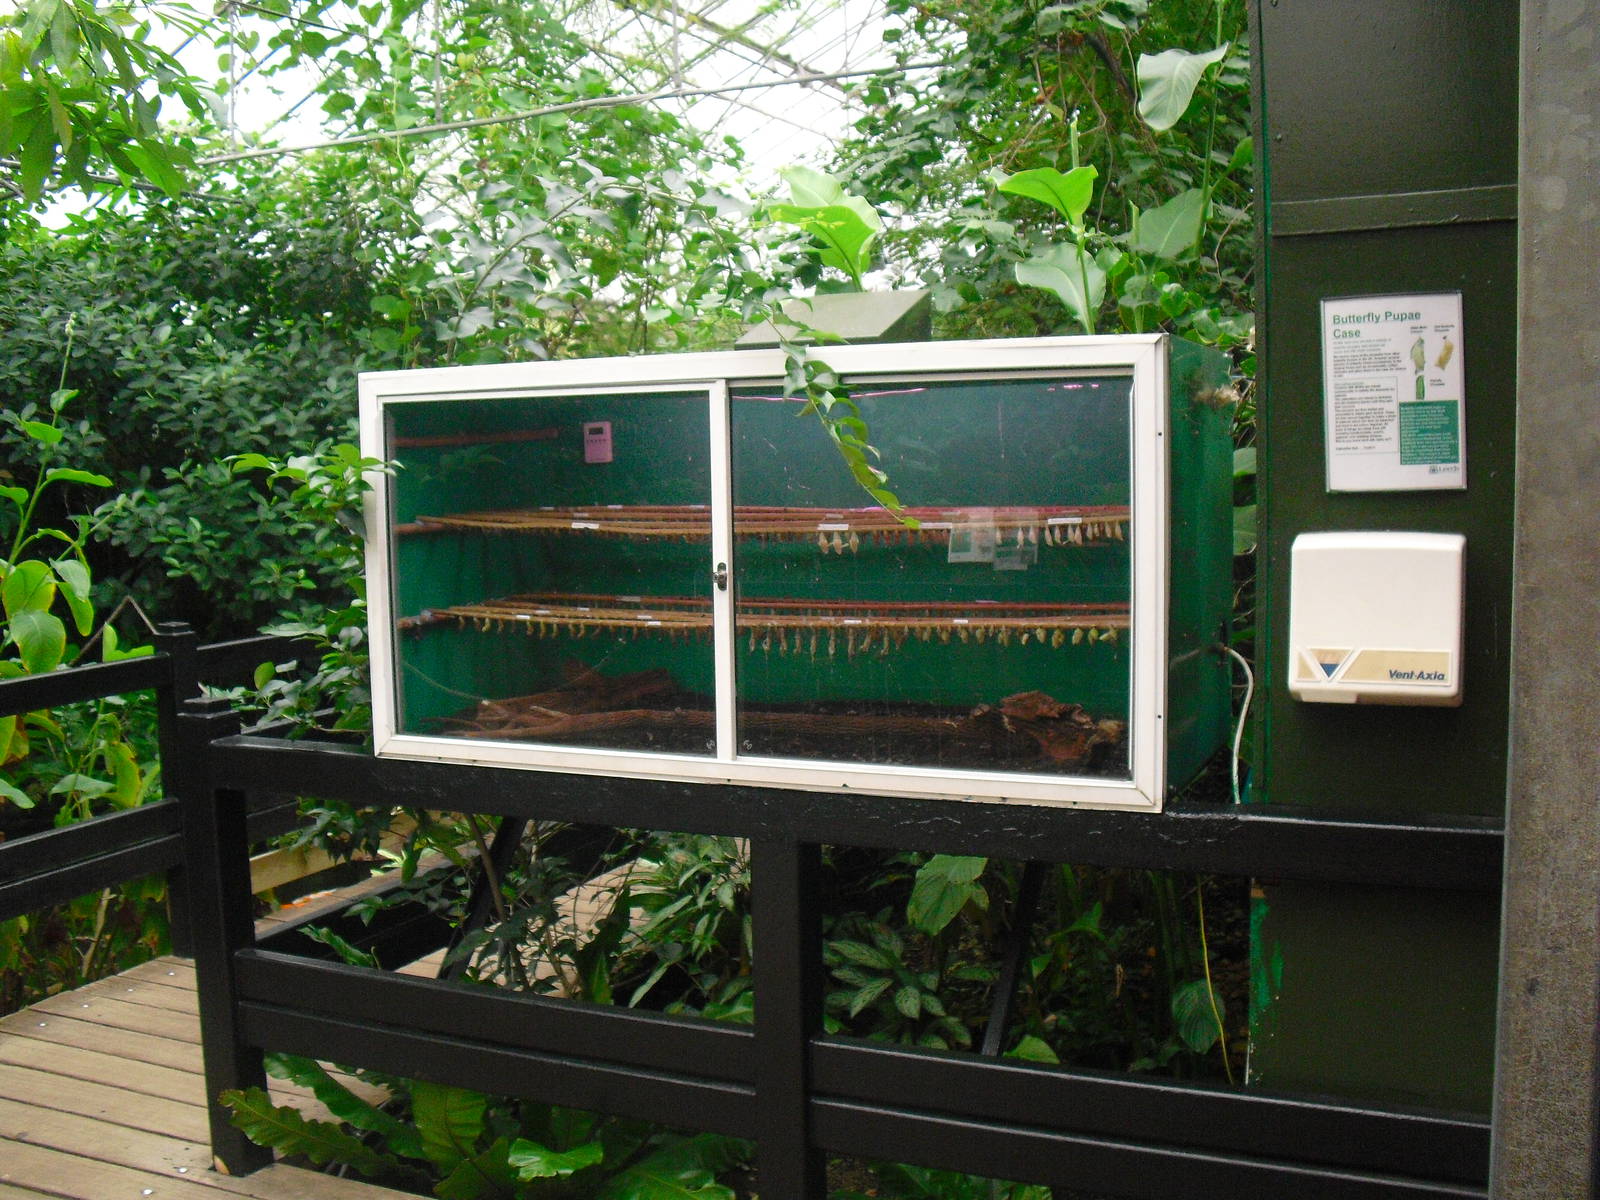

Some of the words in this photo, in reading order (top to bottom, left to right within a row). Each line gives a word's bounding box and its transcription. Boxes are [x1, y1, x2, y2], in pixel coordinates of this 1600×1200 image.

[1333, 312, 1381, 325] Butterfly
[1384, 311, 1421, 323] Pupae
[1333, 328, 1361, 339] Case
[1389, 669, 1445, 681] Vent-Axia
